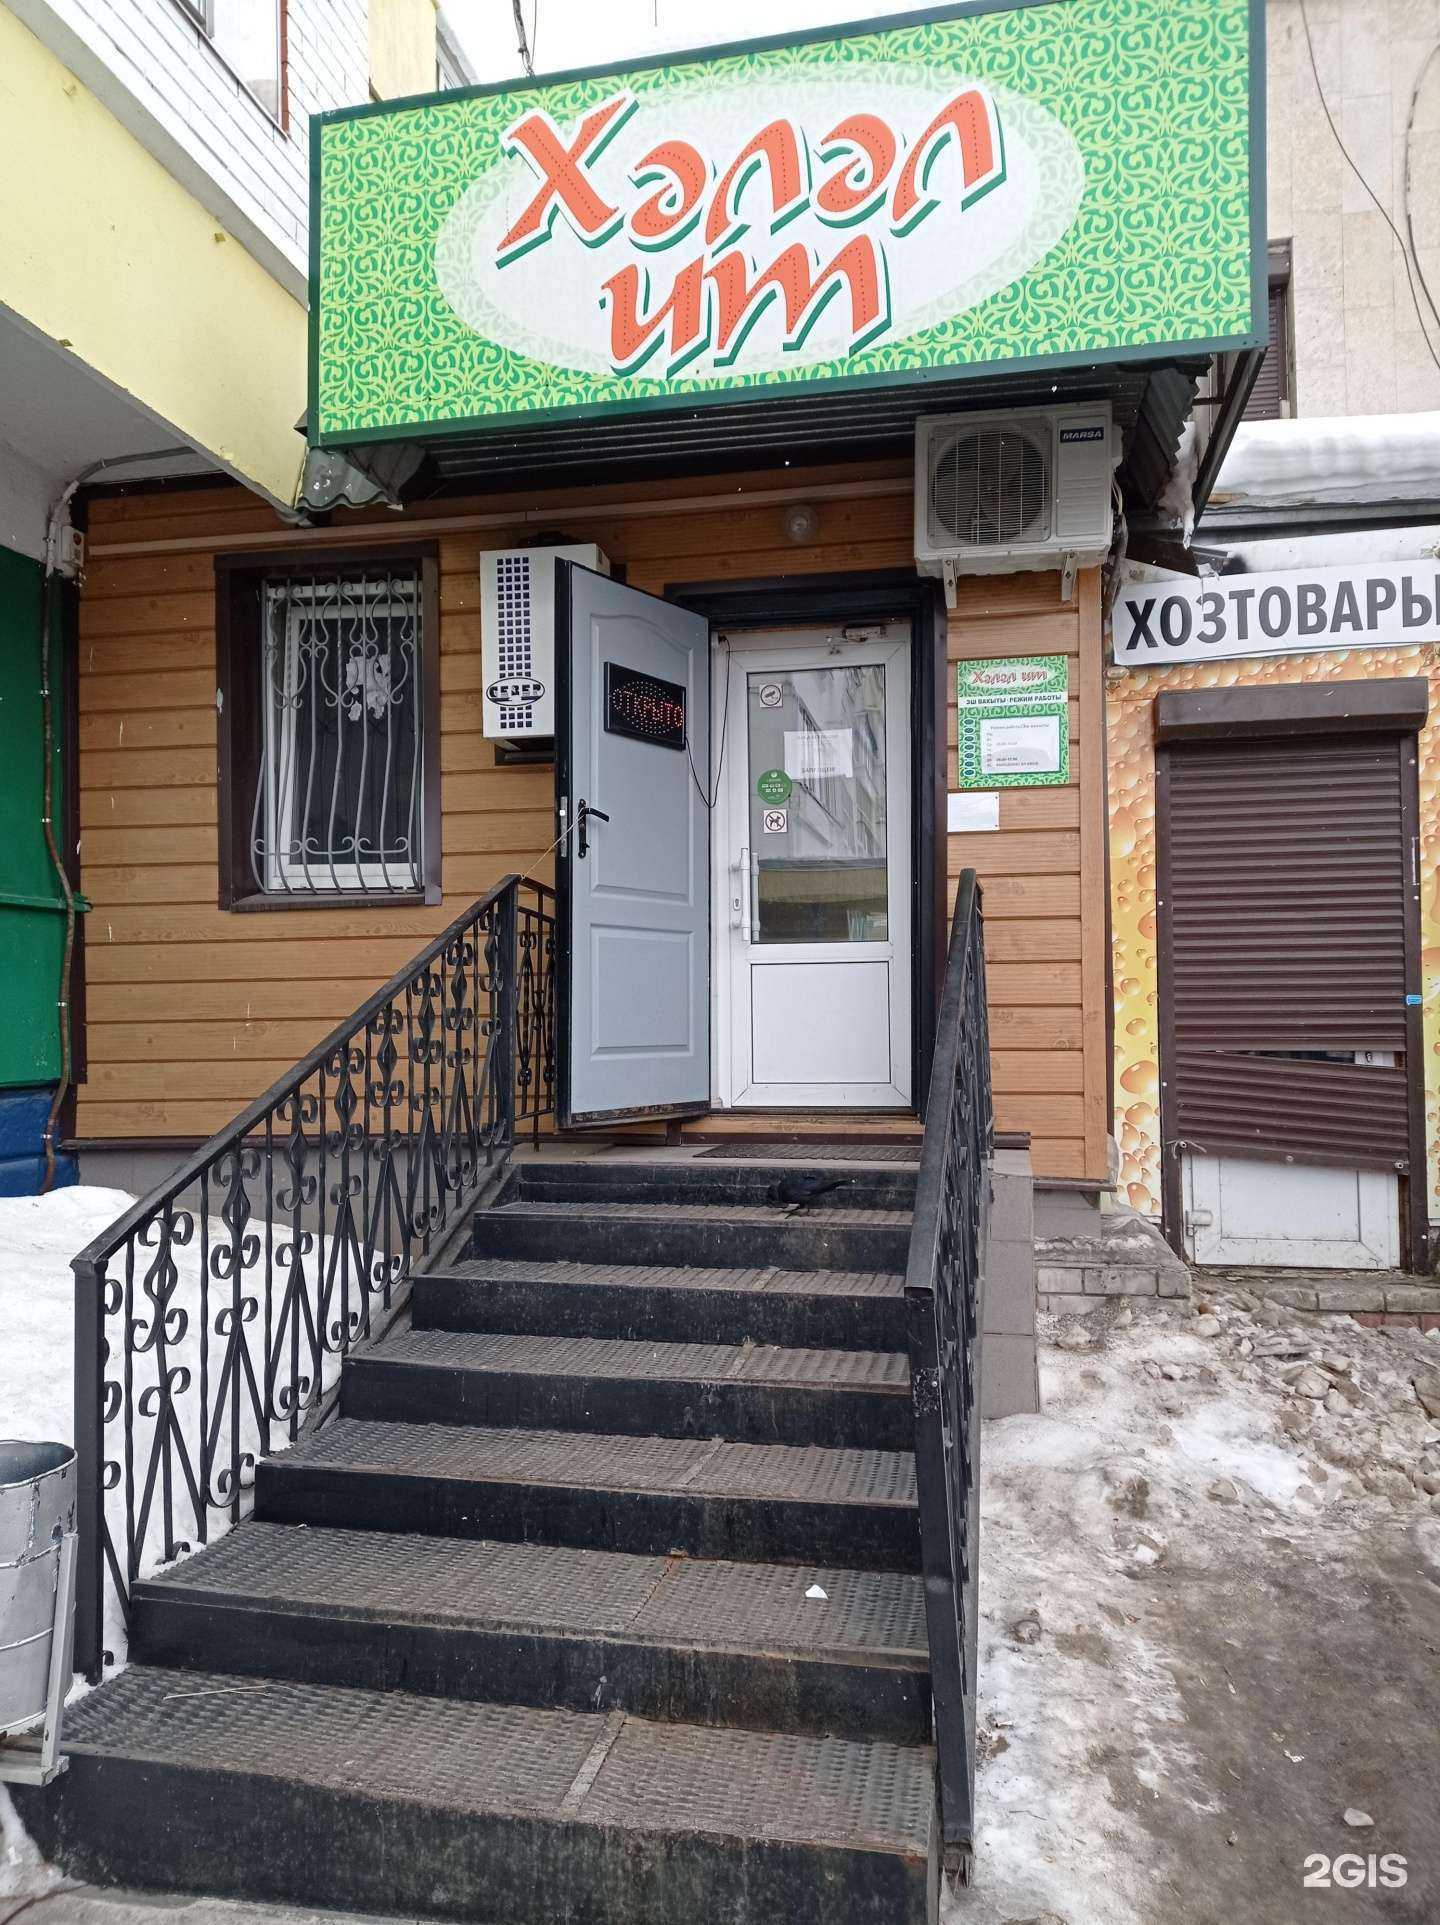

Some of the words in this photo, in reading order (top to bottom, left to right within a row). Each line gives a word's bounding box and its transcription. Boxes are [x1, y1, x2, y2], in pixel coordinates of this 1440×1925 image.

[496, 88, 1007, 268] Хәләл
[600, 234, 892, 378] ит
[1063, 430, 1102, 440] MARSA
[1125, 574, 1440, 651] ХОЗТОВАРЫ
[612, 688, 684, 729] ОТКРЫТО
[978, 697, 1006, 705] ВАКЫТЫ
[1009, 696, 1033, 704] РЕЖИМ
[1034, 694, 1062, 702] РАБОТЫ
